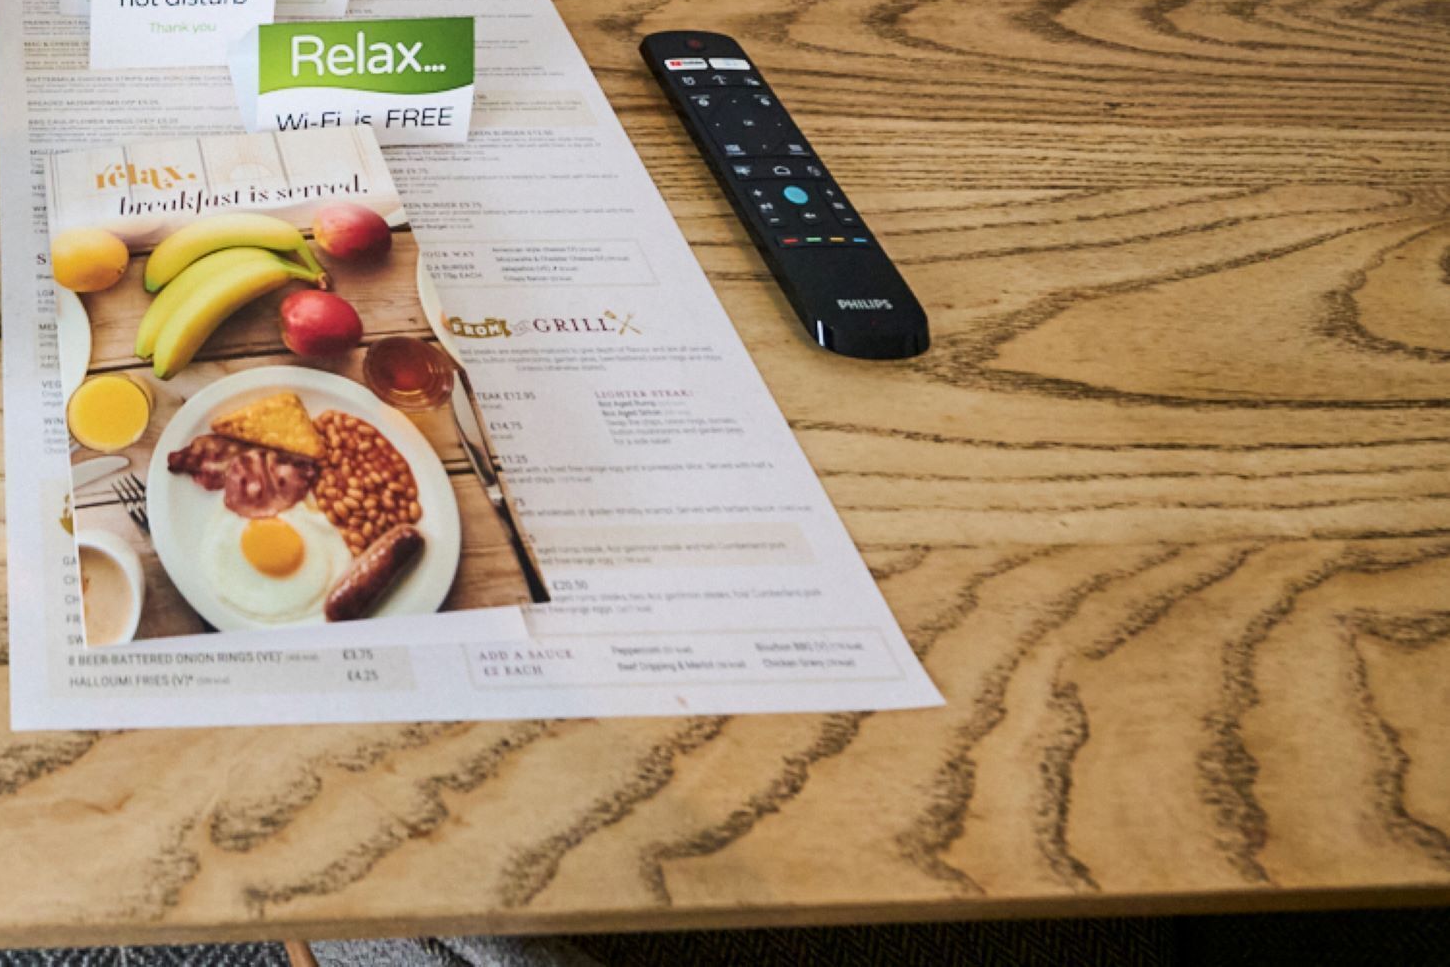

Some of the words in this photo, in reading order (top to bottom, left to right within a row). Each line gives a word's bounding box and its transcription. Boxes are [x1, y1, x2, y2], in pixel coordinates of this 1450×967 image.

[149, 22, 189, 34] Thank
[191, 23, 217, 35] you
[290, 30, 447, 78] Relax...
[276, 109, 341, 130] Wi-Fi
[385, 107, 455, 129] FREE
[120, 189, 240, 215] breakfast
[250, 186, 268, 203] is
[277, 174, 368, 200] served.
[836, 298, 894, 310] PHILIPS
[454, 322, 500, 335] FROM
[532, 318, 615, 332] GRILL
[476, 391, 502, 400] TEAK
[78, 654, 172, 665] BEER-BATTERED
[176, 653, 215, 664] ONION
[217, 652, 254, 663] RINGS
[479, 651, 508, 661] ADD
[514, 650, 523, 660] A
[528, 649, 574, 659] SAUCE
[505, 666, 543, 675] EACH
[70, 676, 132, 687] HALLOUMI
[135, 675, 171, 686] FRIES
